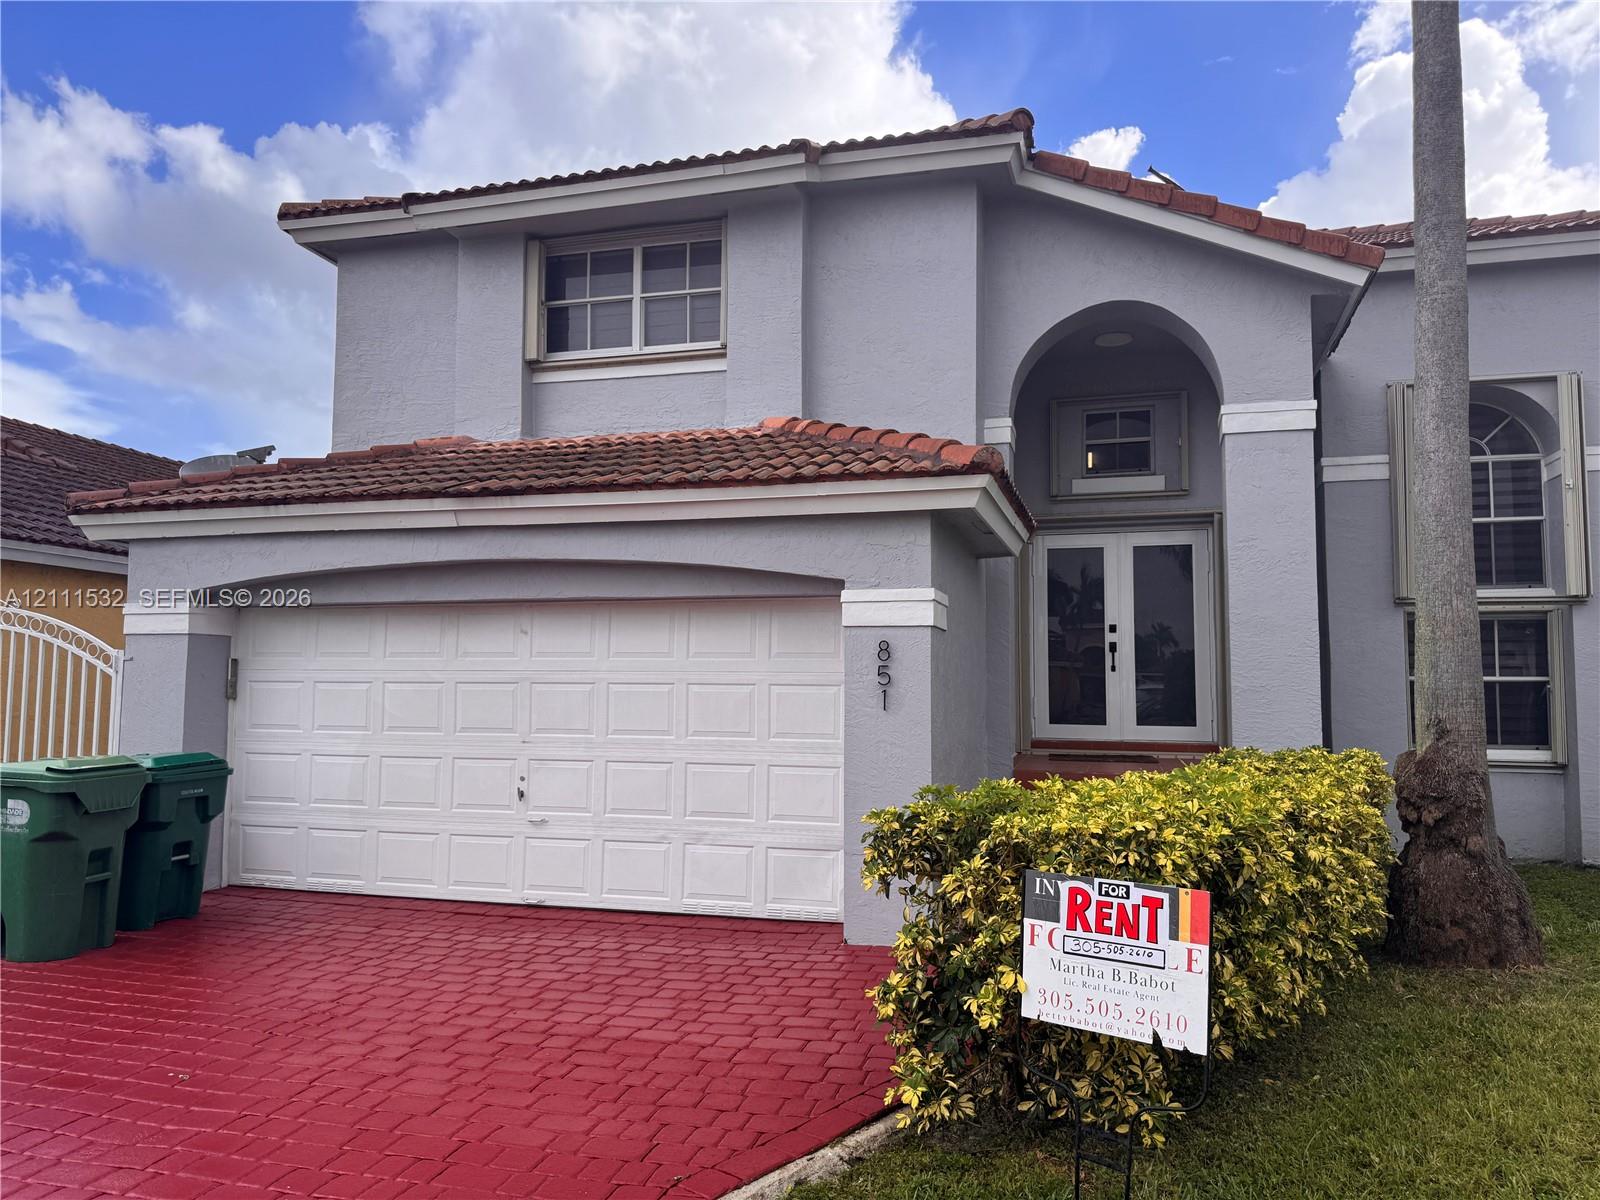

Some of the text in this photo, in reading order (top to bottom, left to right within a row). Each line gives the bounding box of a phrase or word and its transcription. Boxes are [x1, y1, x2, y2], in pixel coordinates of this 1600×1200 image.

[877, 640, 892, 711] 851
[1101, 884, 1127, 898] FOR
[1066, 886, 1164, 944] RENT
[1070, 938, 1154, 958] 305-505-2610
[1049, 957, 1105, 980] Martha
[1063, 977, 1160, 1003] Lic. Real Estate Agent
[1038, 987, 1188, 1034] 305.505.2610
